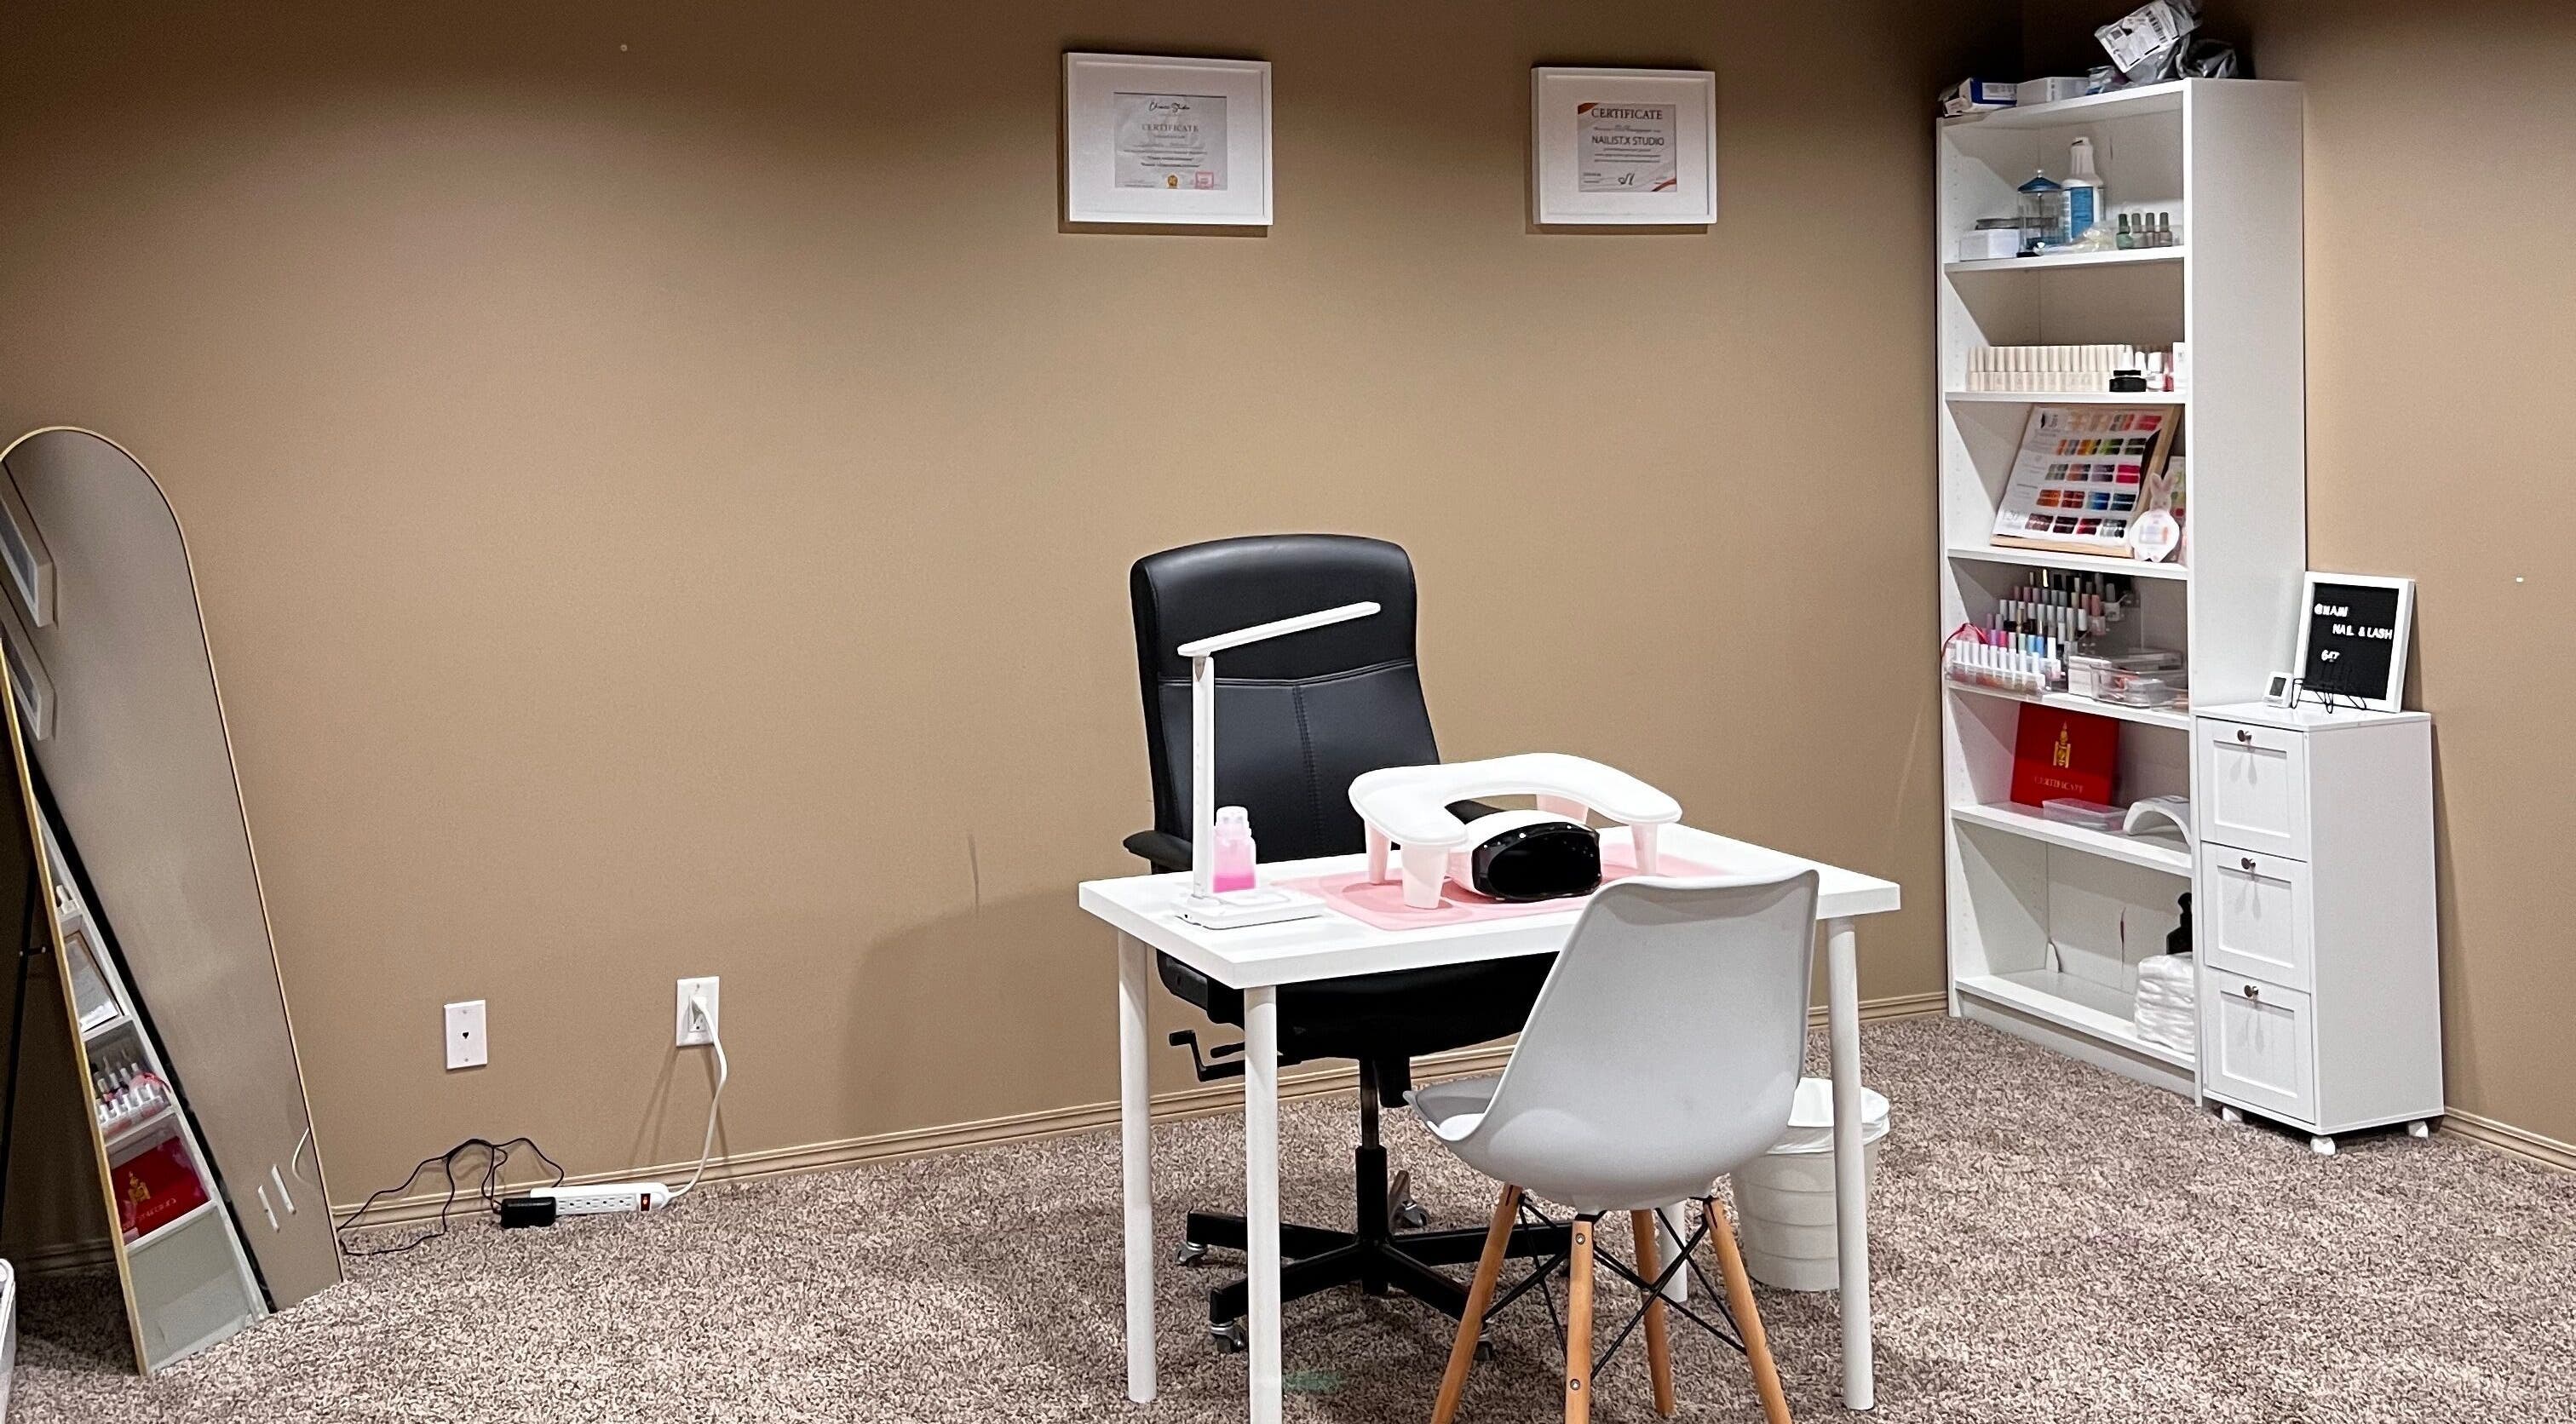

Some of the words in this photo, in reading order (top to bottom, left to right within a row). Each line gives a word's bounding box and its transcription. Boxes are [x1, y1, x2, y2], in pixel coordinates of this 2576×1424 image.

[1591, 107, 1663, 120] CERTIFICATE
[1141, 123, 1199, 132] CERTIFICATE
[1632, 136, 1665, 146] STUDIO
[2332, 623, 2355, 636] NAIL
[2358, 626, 2366, 637] &
[2367, 627, 2393, 640] LASH
[2033, 776, 2085, 793] CERTIFICATE
